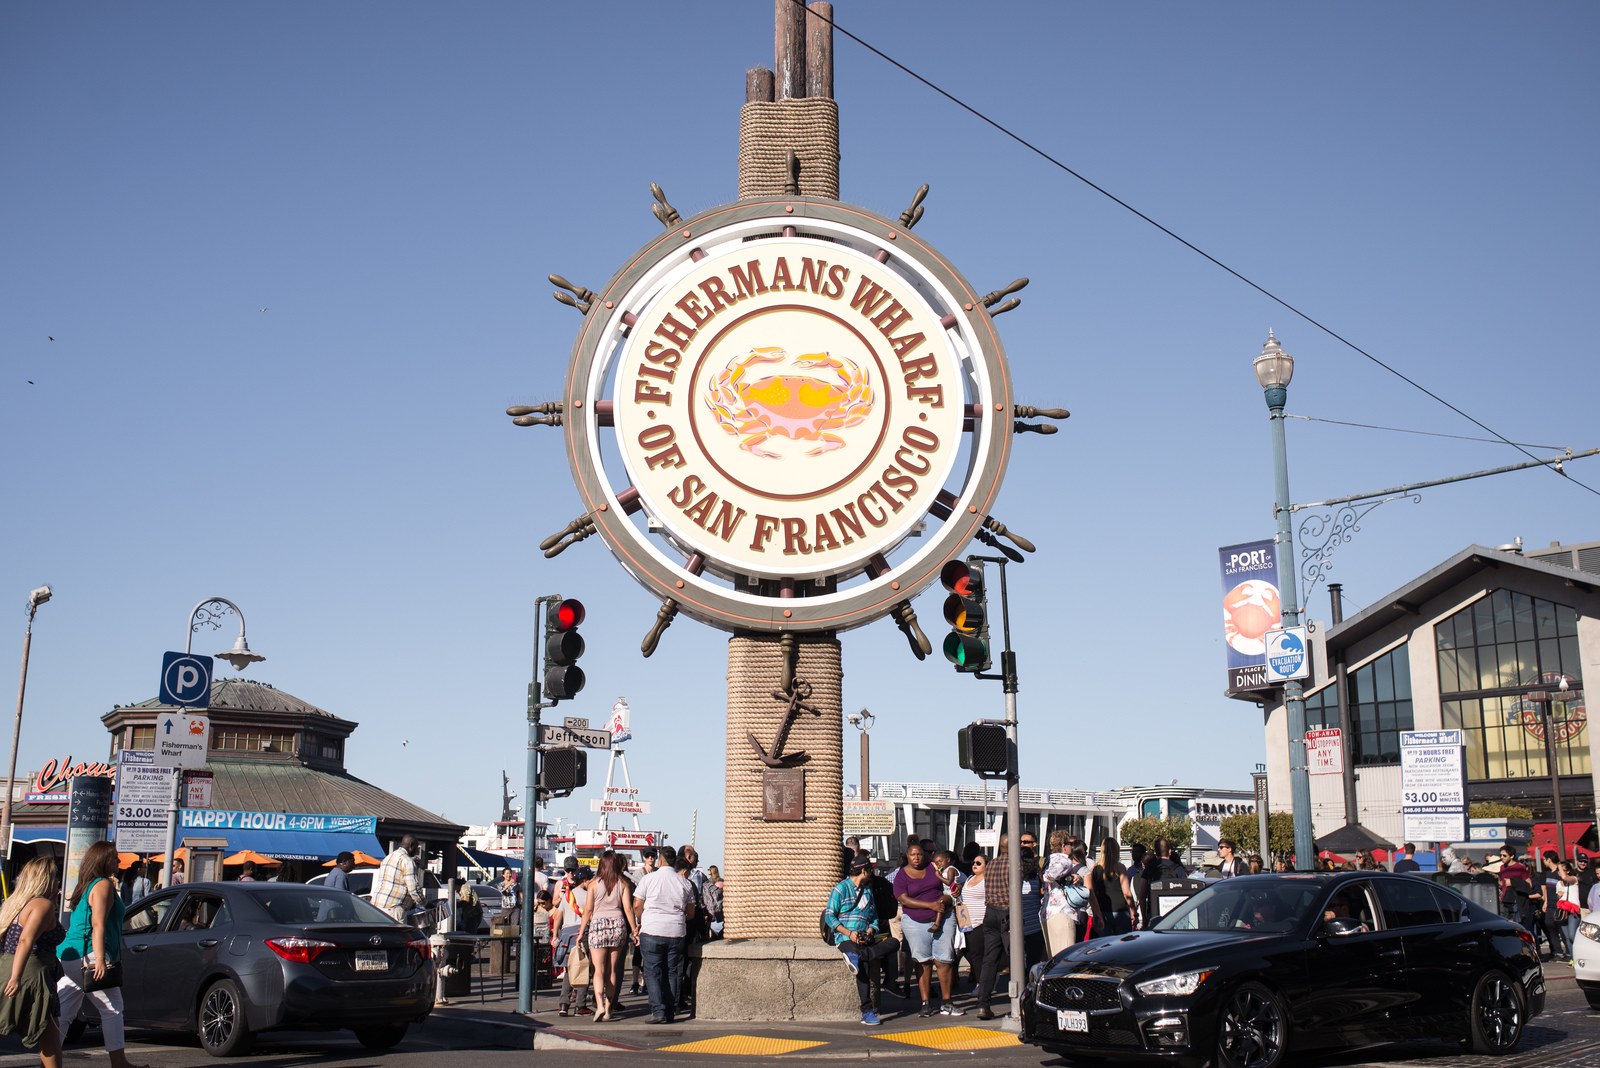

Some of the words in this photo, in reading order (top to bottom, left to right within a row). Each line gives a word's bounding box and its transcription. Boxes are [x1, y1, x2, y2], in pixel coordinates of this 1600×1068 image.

[634, 256, 851, 407] FISHERMANS
[849, 273, 945, 409] WHARF
[637, 423, 686, 471] OF
[667, 474, 747, 542] SAN
[749, 425, 940, 555] FRANCISCO
[1230, 549, 1266, 568] PORT
[1238, 562, 1273, 573] FRANCISCO
[1272, 654, 1302, 667] EVACUATION
[1280, 664, 1295, 673] ROUTE
[547, 730, 606, 745] Jefferson
[1308, 730, 1339, 738] TOW-AWAY
[1403, 734, 1437, 745] Fisherman's
[1438, 732, 1457, 743] Wharf
[162, 741, 203, 751] Fisherman's
[1307, 739, 1317, 749] NO
[1318, 738, 1340, 748] STOPPING
[161, 749, 182, 757] Wharf
[1317, 758, 1333, 766] TIME
[1405, 792, 1437, 803] $3.00
[120, 807, 152, 818] $3.00
[181, 810, 240, 828] HAPPY
[240, 813, 286, 830] HOUR
[289, 817, 324, 830] 4-6PM
[330, 817, 372, 827] WEEKDAYS
[1508, 828, 1525, 838] CHASE
[1059, 1016, 1087, 1030] 7JLH393
